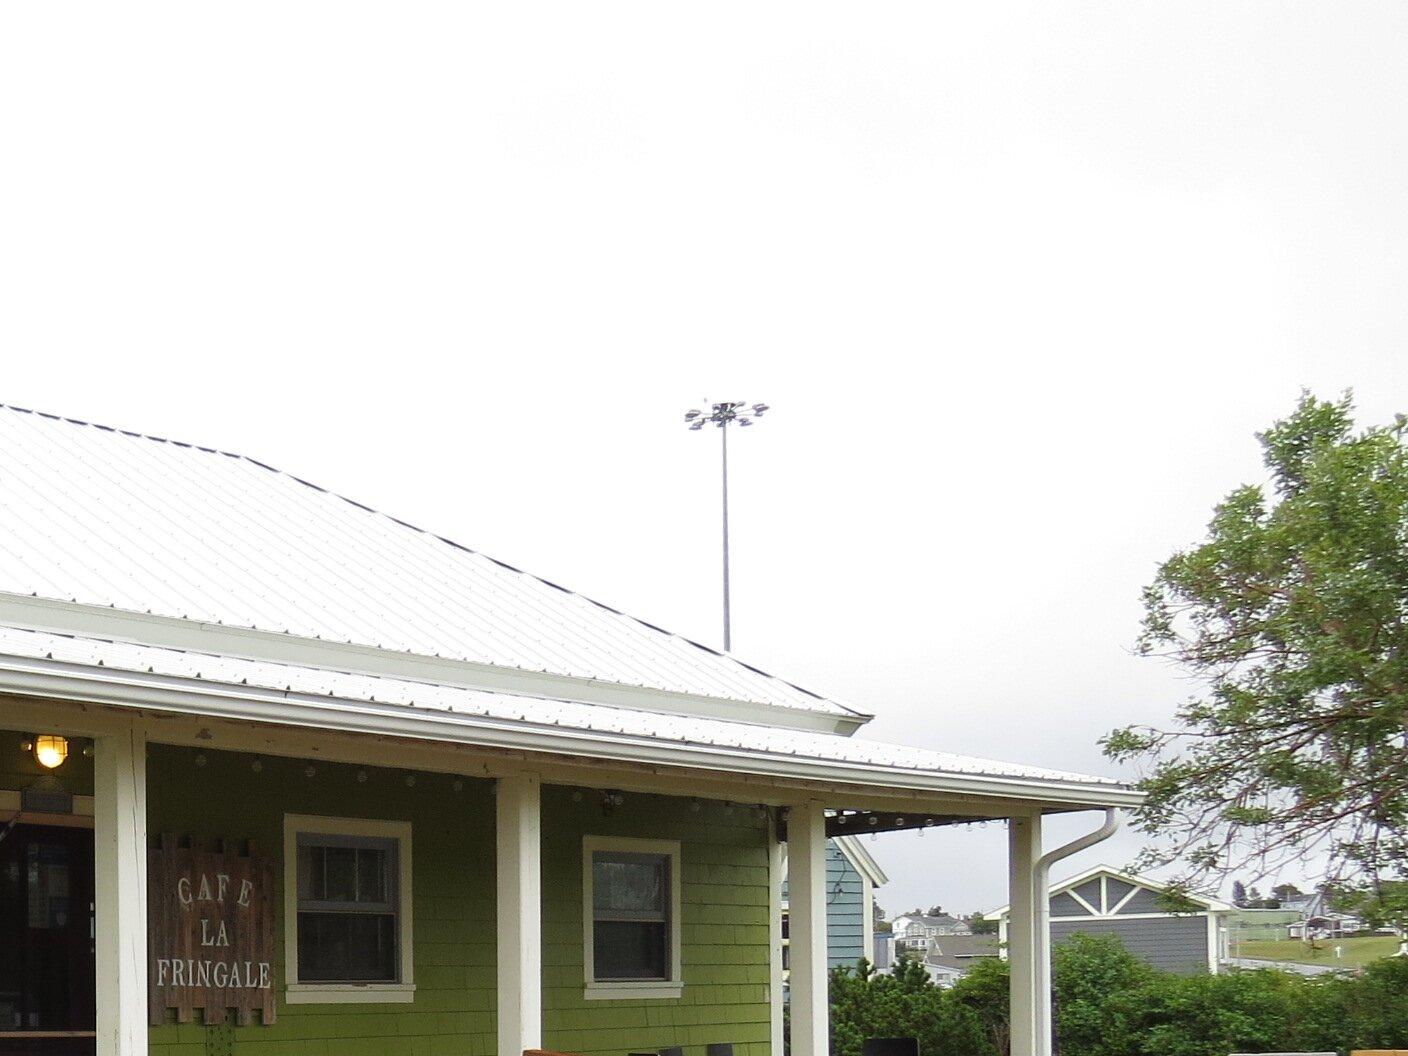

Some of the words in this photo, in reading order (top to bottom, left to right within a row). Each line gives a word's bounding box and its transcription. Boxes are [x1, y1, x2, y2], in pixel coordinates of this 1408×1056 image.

[178, 873, 253, 907] CAFE
[201, 919, 230, 947] LA
[157, 959, 271, 989] FRINGALE
